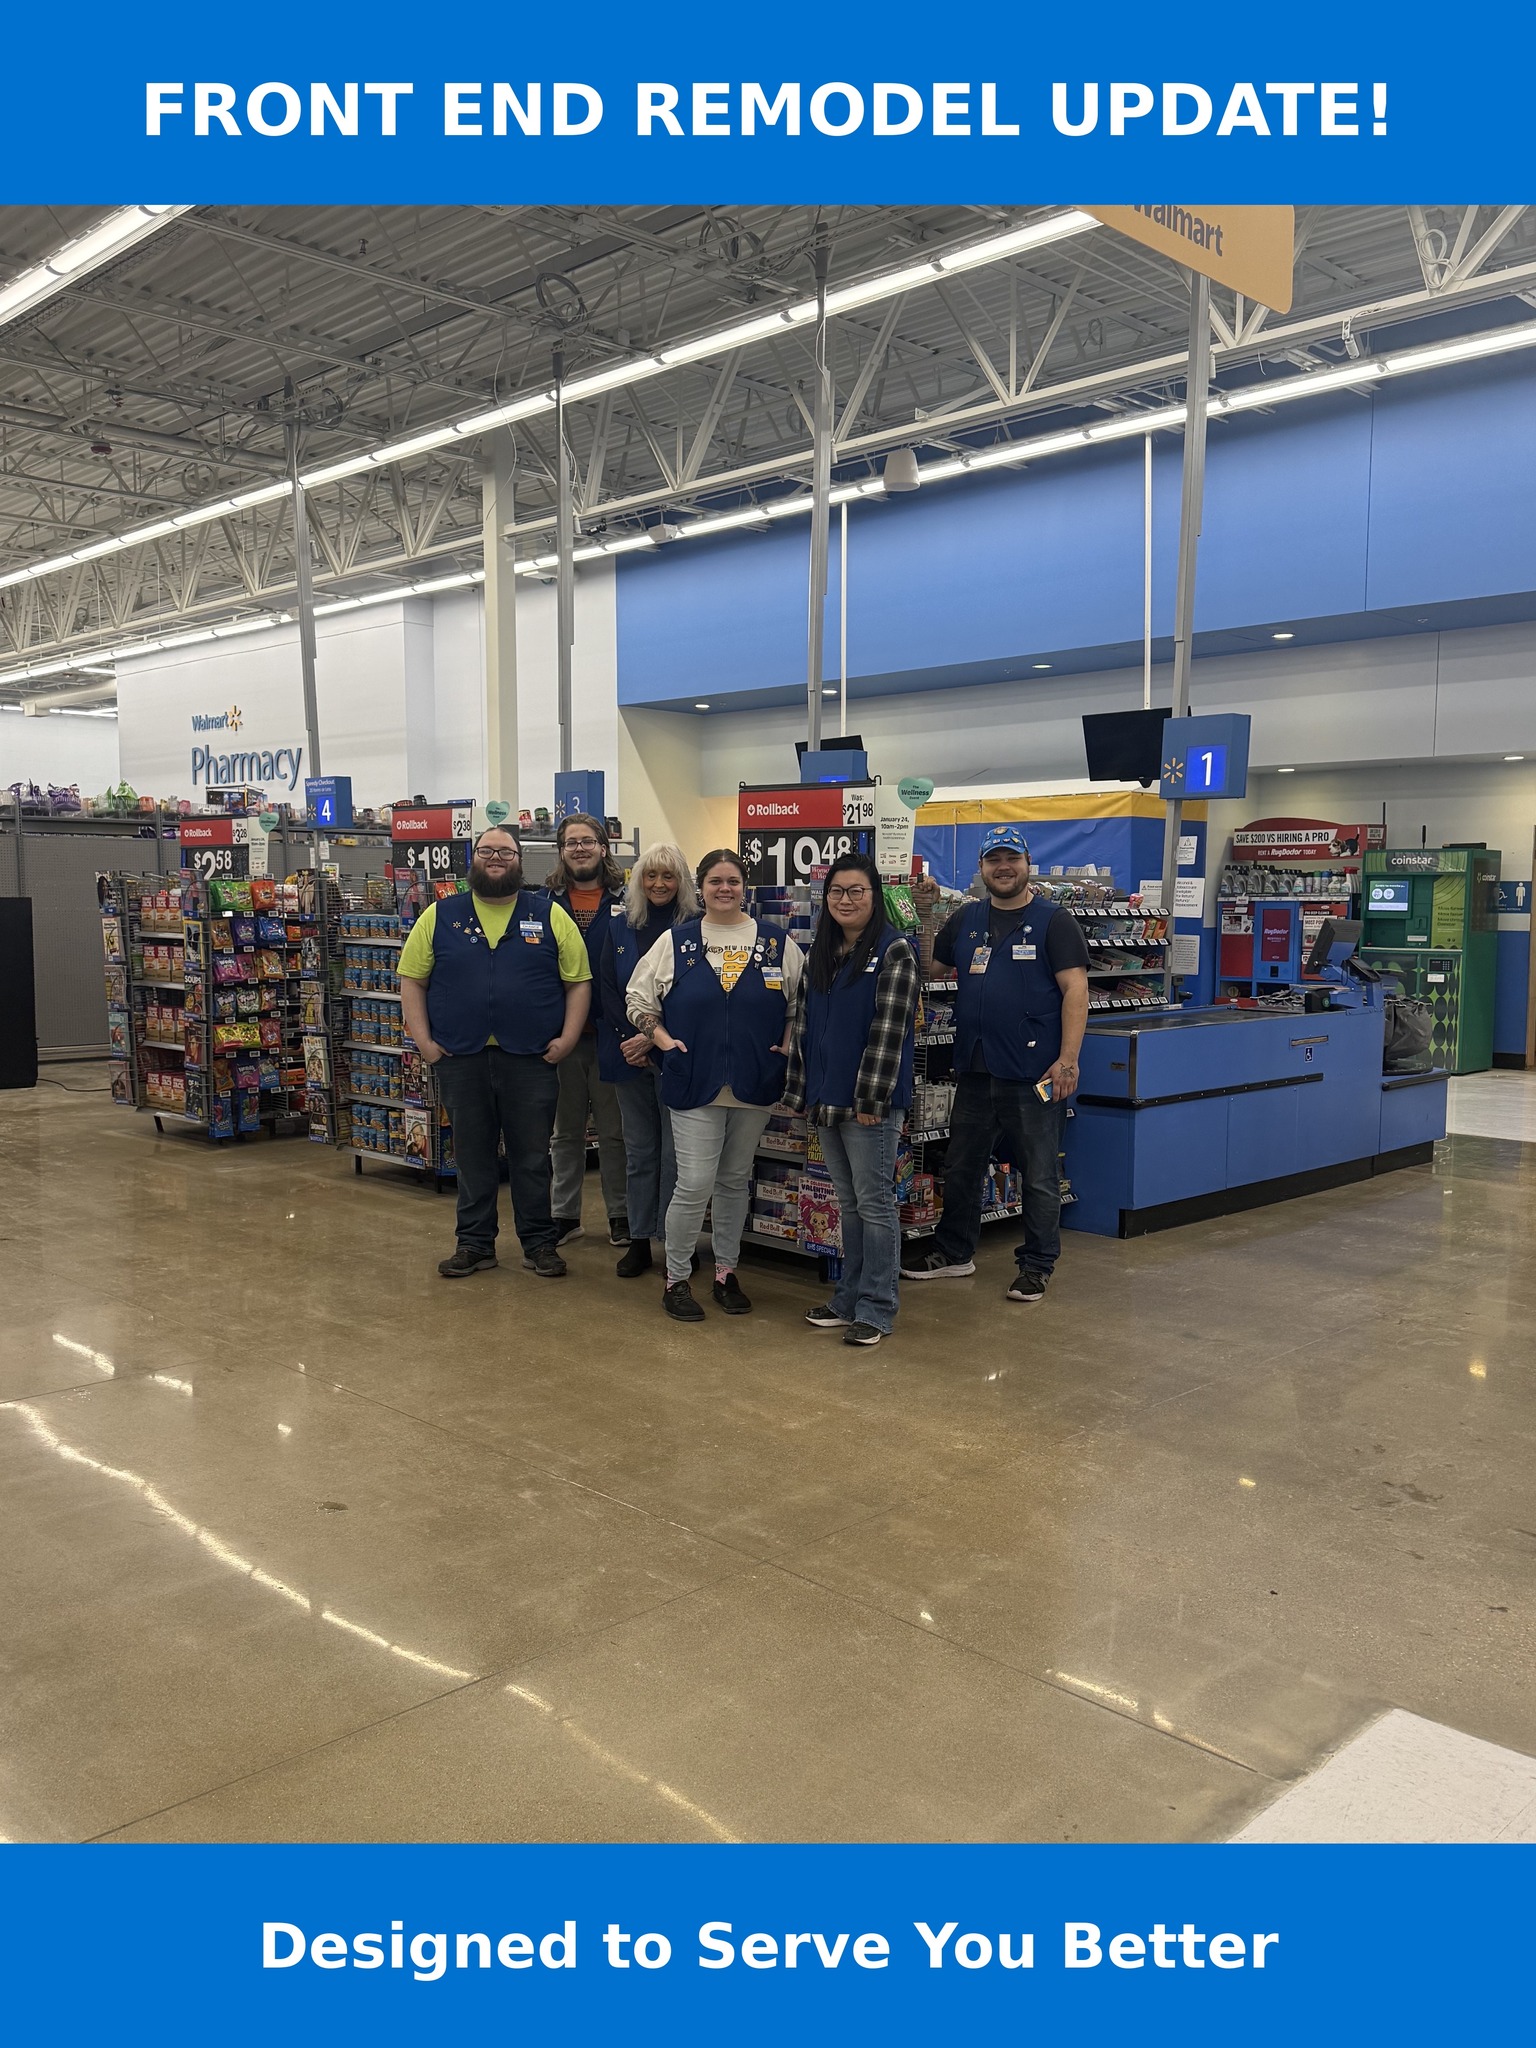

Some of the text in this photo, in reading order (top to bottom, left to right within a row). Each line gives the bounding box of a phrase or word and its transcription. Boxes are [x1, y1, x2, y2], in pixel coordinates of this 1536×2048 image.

[191, 711, 229, 732] Walmart
[191, 744, 302, 791] Pharmacy
[1201, 751, 1212, 786] 1
[572, 796, 582, 814] 3
[756, 802, 800, 816] Rollback
[321, 799, 331, 822] 4
[401, 819, 428, 830] Rollback
[880, 816, 901, 824] January
[881, 823, 909, 831] 10am-2pm
[189, 828, 213, 838] Rollback
[1236, 831, 1329, 844] SAVE $200 VS HIRING A PRO
[1270, 848, 1302, 858] RugDoctor
[1391, 855, 1433, 865] coinstar
[184, 974, 202, 984] SOUPS
[776, 1138, 787, 1146] Bull
[762, 1187, 783, 1196] Red Bull
[759, 1222, 780, 1232] Red Bull
[816, 1244, 836, 1256] SPECIALS
